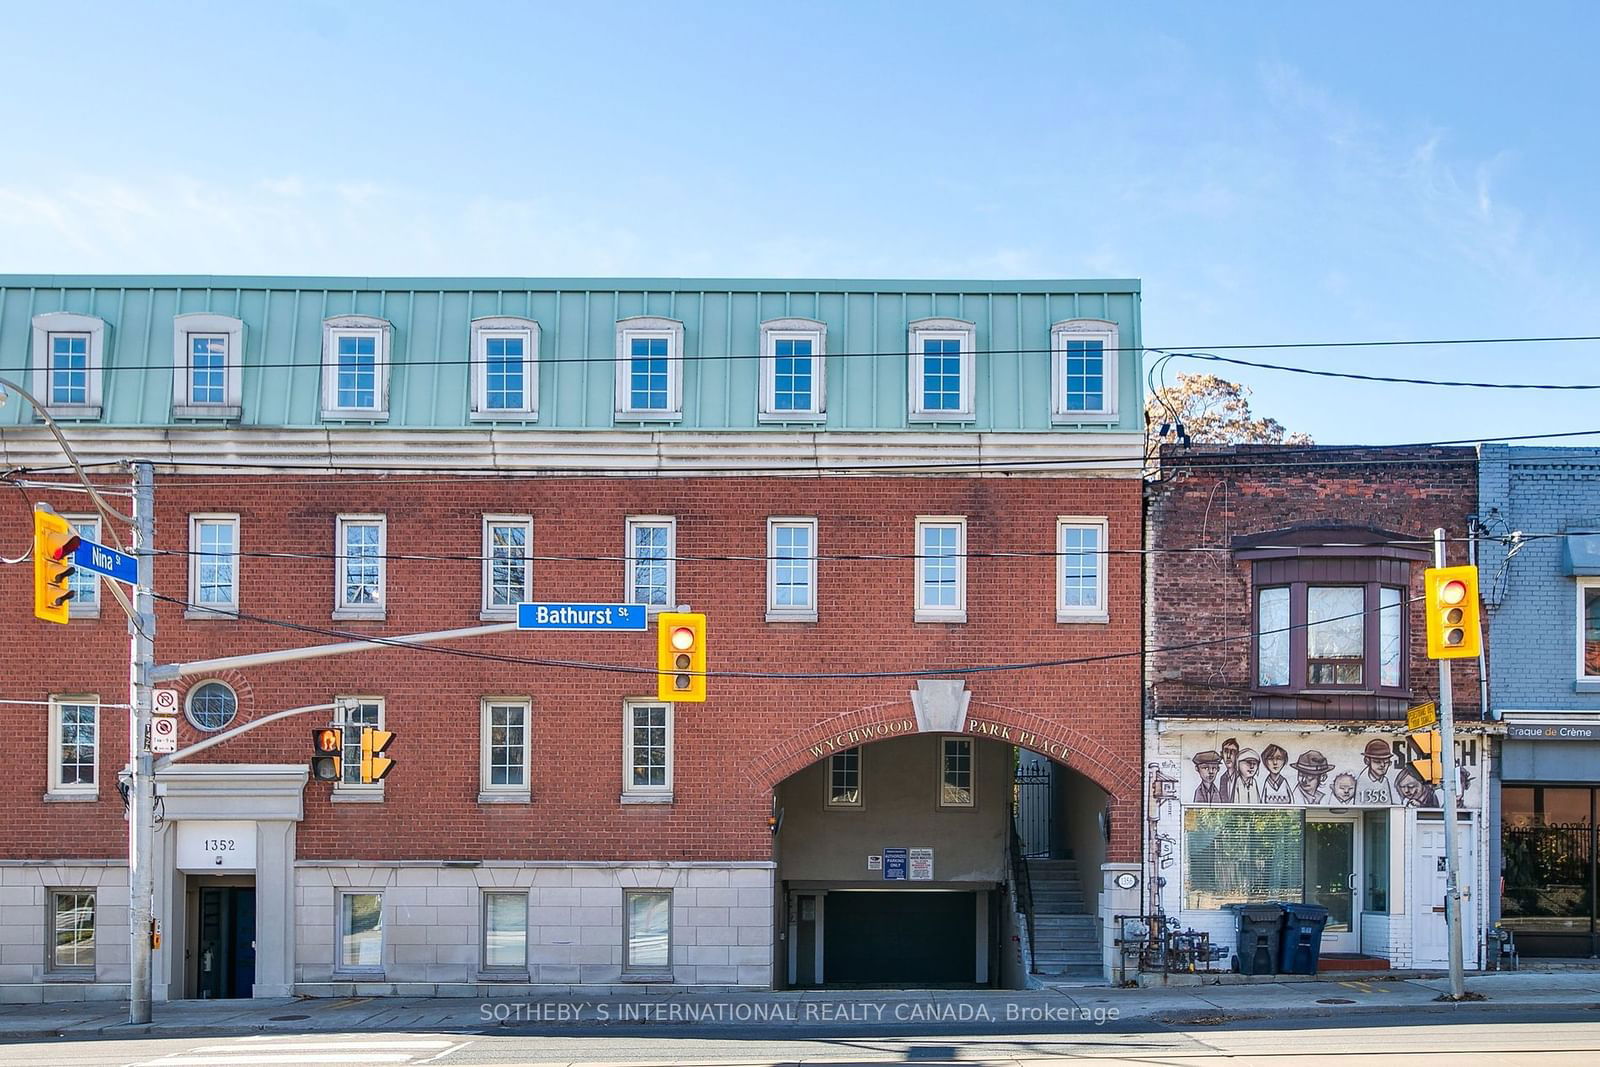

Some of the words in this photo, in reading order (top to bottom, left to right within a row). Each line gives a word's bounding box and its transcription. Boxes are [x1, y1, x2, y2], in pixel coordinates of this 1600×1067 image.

[92, 546, 113, 571] Nina
[536, 606, 612, 625] Bathurst
[809, 719, 913, 759] WYCHWOOD
[969, 719, 1012, 740] PARK
[1019, 731, 1072, 761] PLACE
[1508, 727, 1543, 737] Craque
[1544, 727, 1557, 737] de
[1560, 727, 1592, 737] Crème
[1360, 789, 1388, 804] 1358
[204, 839, 235, 851] 1352
